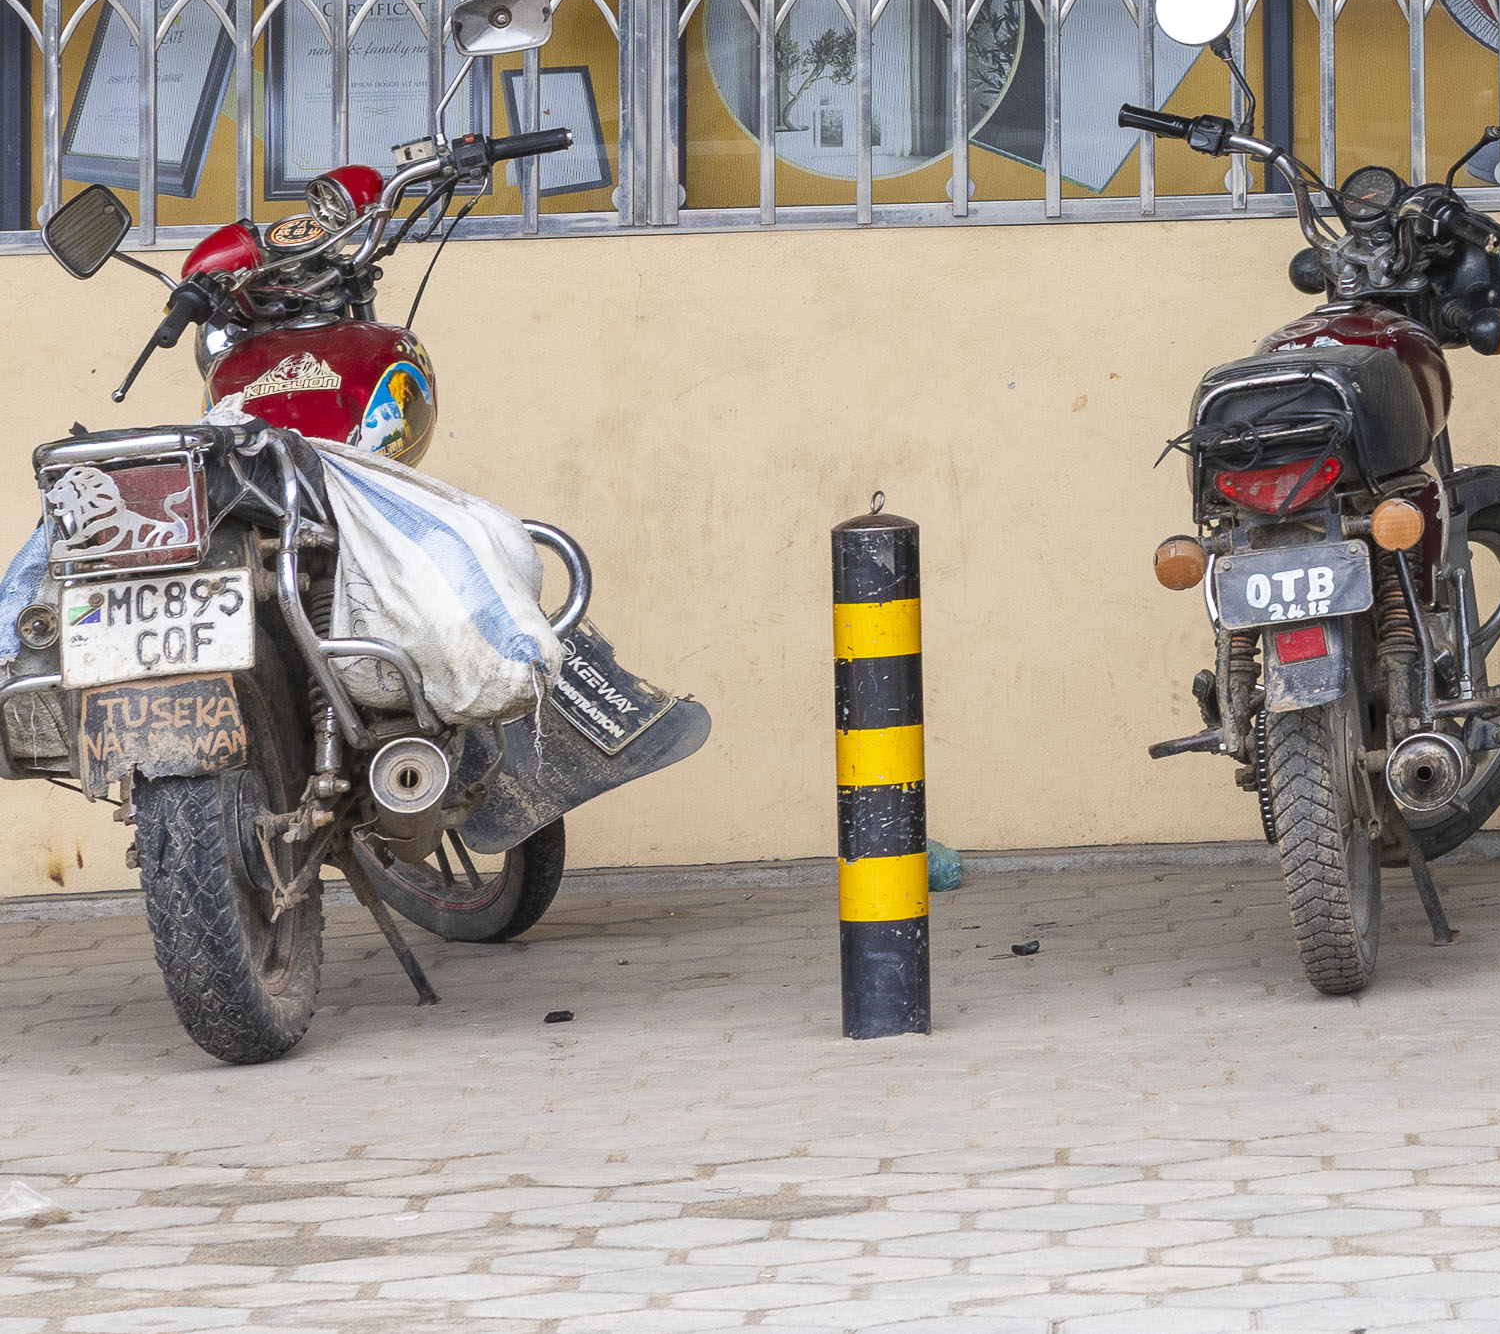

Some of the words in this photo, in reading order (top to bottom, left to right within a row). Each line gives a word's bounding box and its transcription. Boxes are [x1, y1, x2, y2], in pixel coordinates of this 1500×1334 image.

[107, 575, 244, 627] MC895
[568, 655, 641, 714] KEEWAY
[96, 695, 241, 729] TUSEKA
